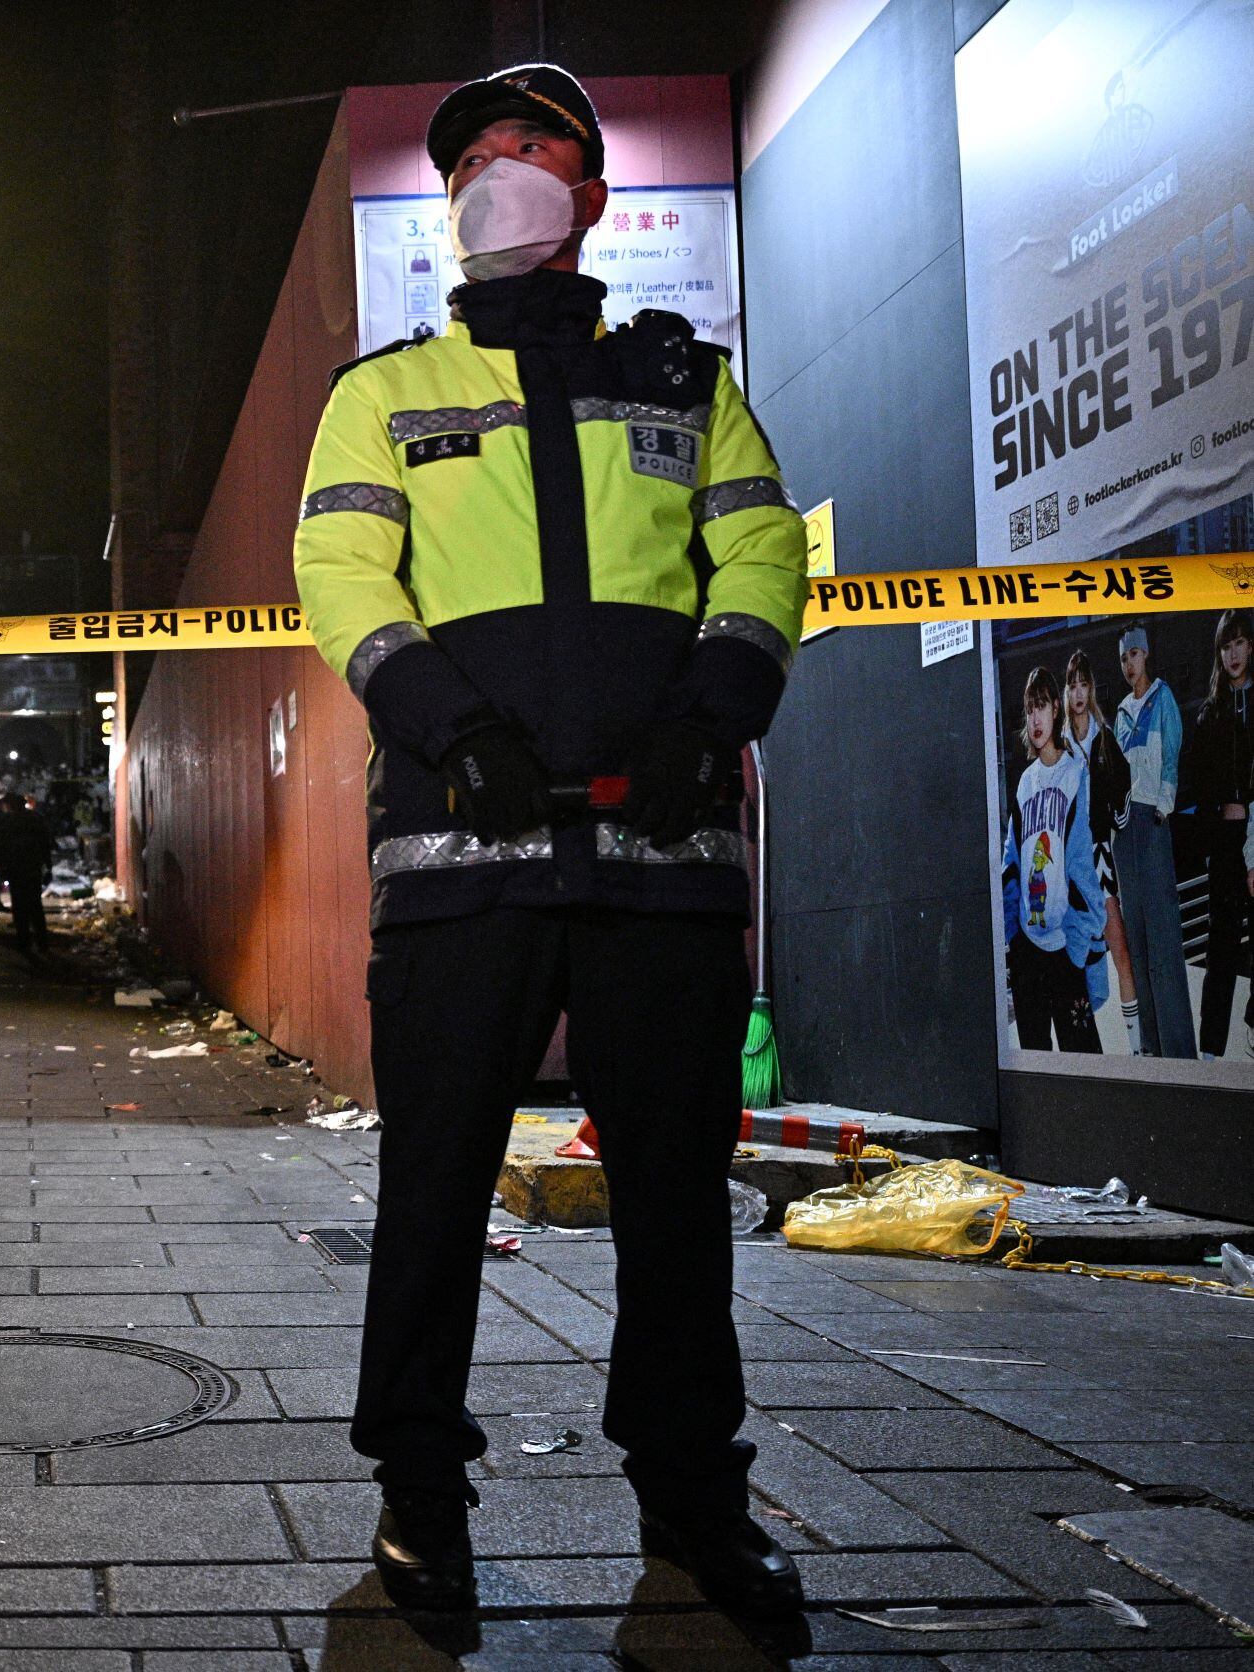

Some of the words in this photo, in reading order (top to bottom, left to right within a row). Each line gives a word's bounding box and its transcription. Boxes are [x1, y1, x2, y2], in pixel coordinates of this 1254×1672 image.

[1071, 217, 1108, 262] Foot
[1112, 171, 1175, 232] Locker
[598, 249, 618, 260] 신발
[629, 247, 662, 259] Shoes
[673, 246, 692, 257] くつ
[606, 283, 633, 294] 죽의류
[642, 281, 677, 293] Leather
[686, 280, 714, 292] 皮製品
[989, 338, 1039, 418] ON
[1048, 280, 1130, 380] THE
[992, 347, 1133, 492] SINCE
[635, 427, 658, 452] 경
[638, 456, 692, 480] POLICE
[1084, 451, 1183, 508] footlockerkorea.kr
[958, 565, 1174, 607] LINE-수사중
[49, 607, 309, 641] 출입금지-POLIC
